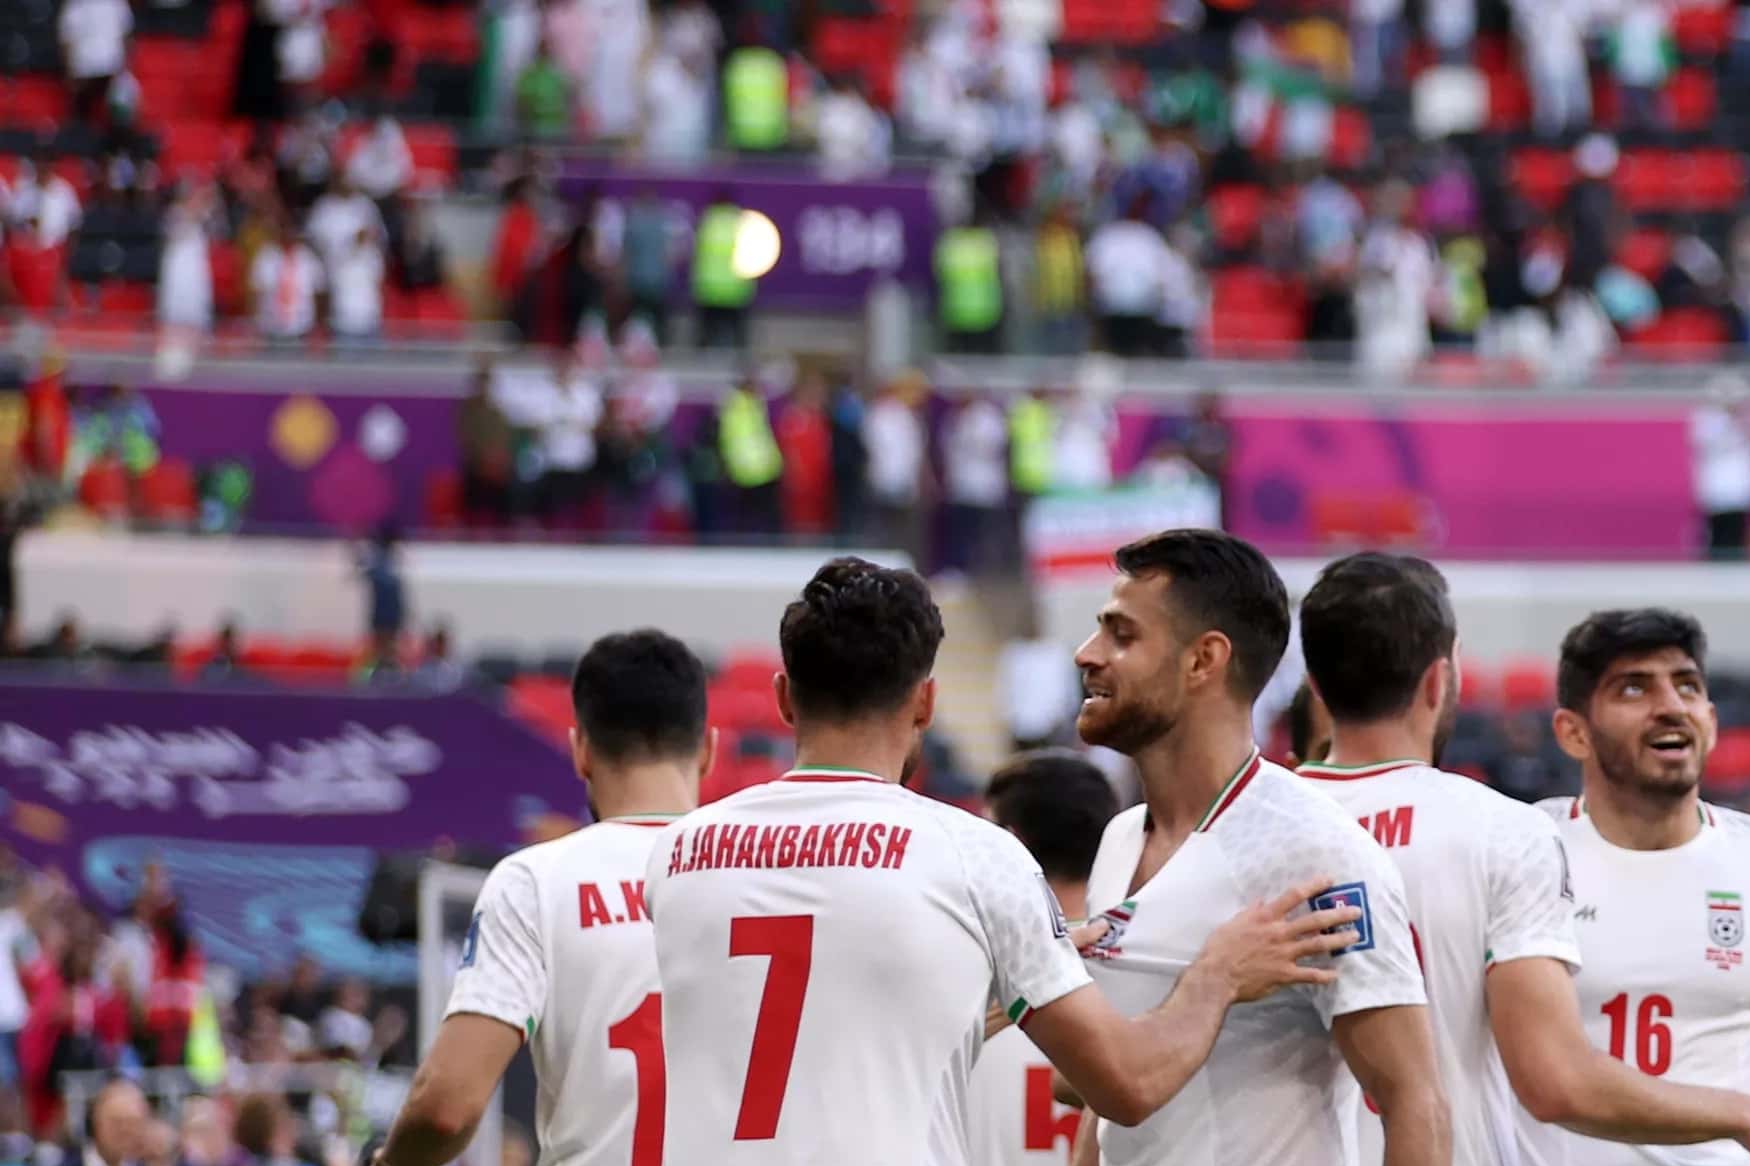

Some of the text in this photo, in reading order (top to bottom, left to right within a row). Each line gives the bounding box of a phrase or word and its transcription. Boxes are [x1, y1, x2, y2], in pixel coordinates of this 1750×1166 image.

[667, 822, 911, 878] A.JAHANBAKHSH
[729, 914, 814, 1141] 7
[1601, 992, 1673, 1077] 16
